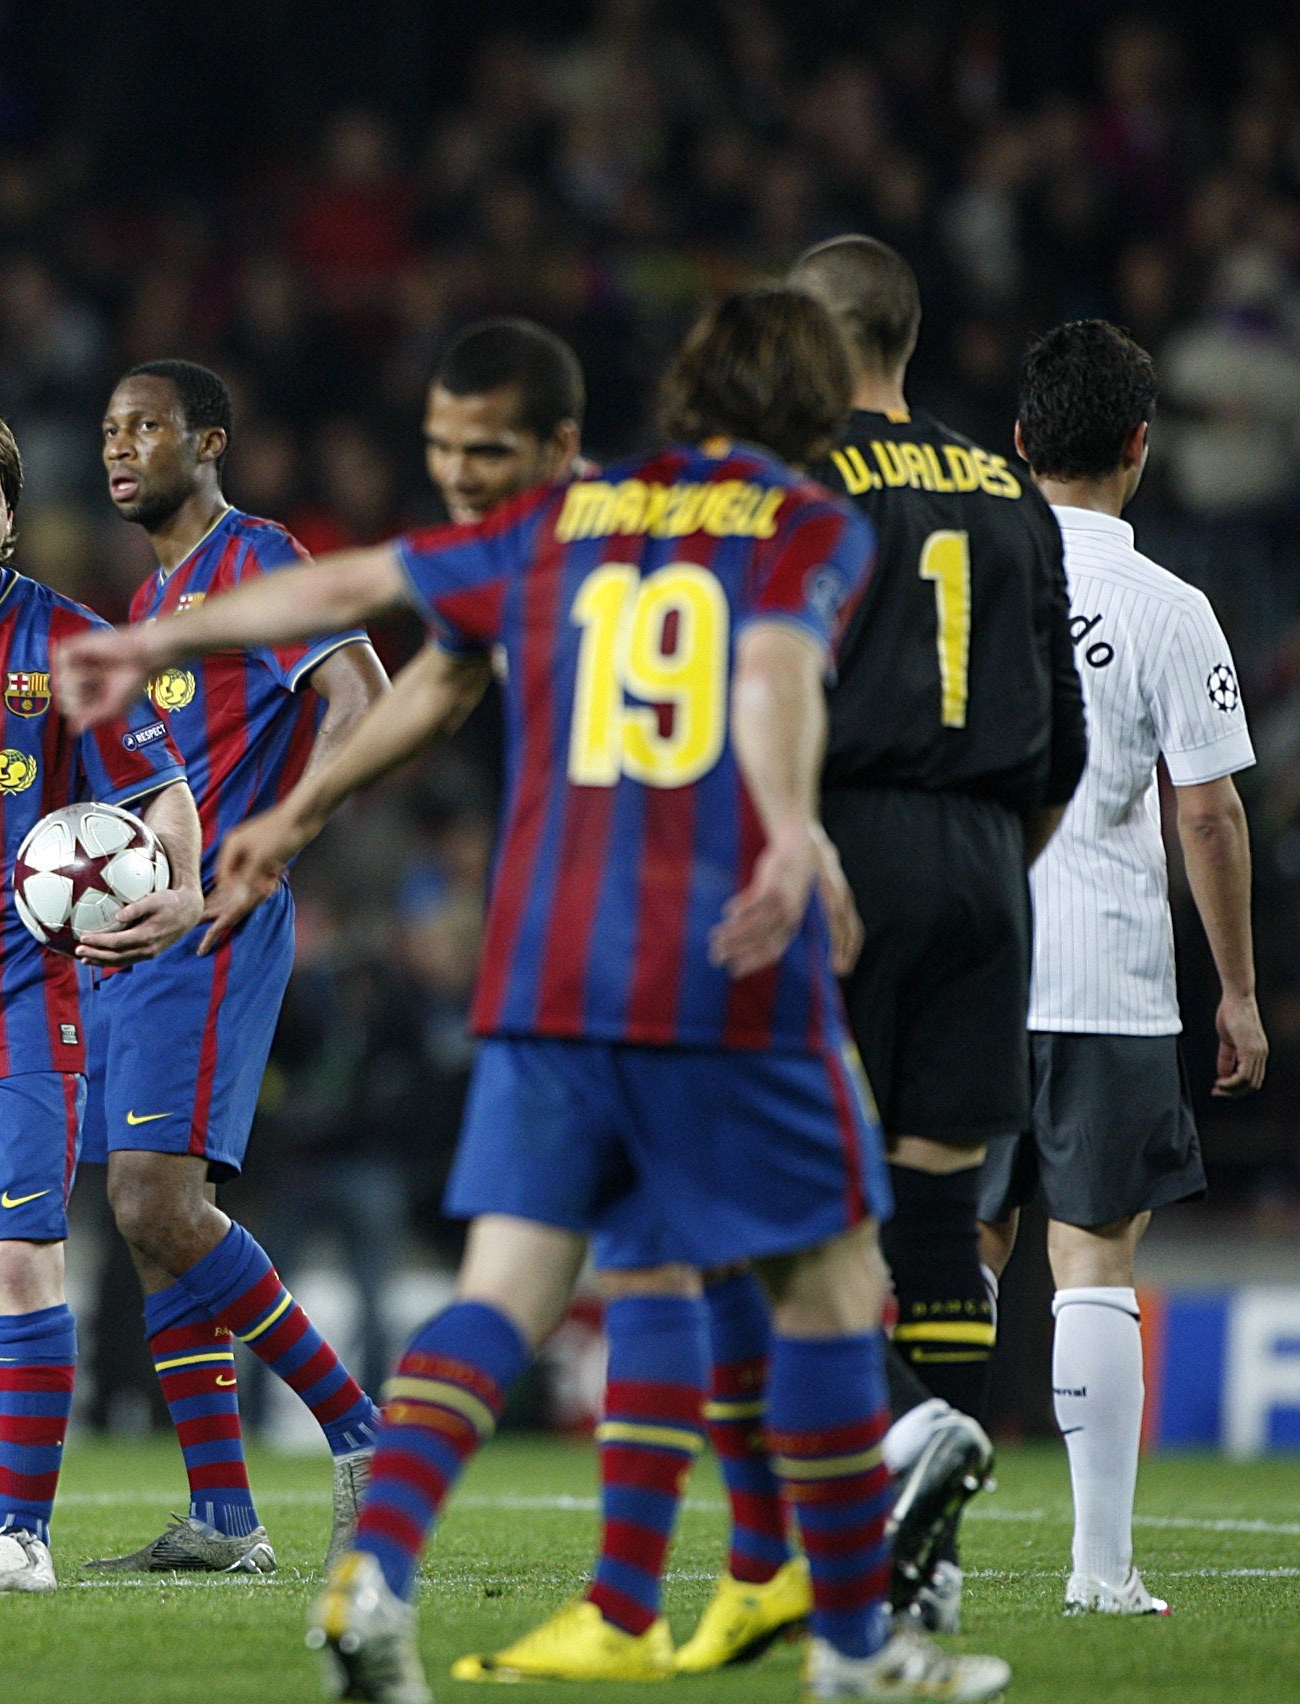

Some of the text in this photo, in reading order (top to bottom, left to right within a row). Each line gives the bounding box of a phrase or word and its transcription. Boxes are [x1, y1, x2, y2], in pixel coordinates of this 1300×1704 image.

[554, 479, 786, 542] MAXWELL
[567, 560, 730, 789] 19
[918, 528, 971, 729] 1
[135, 724, 167, 744] RESPECT
